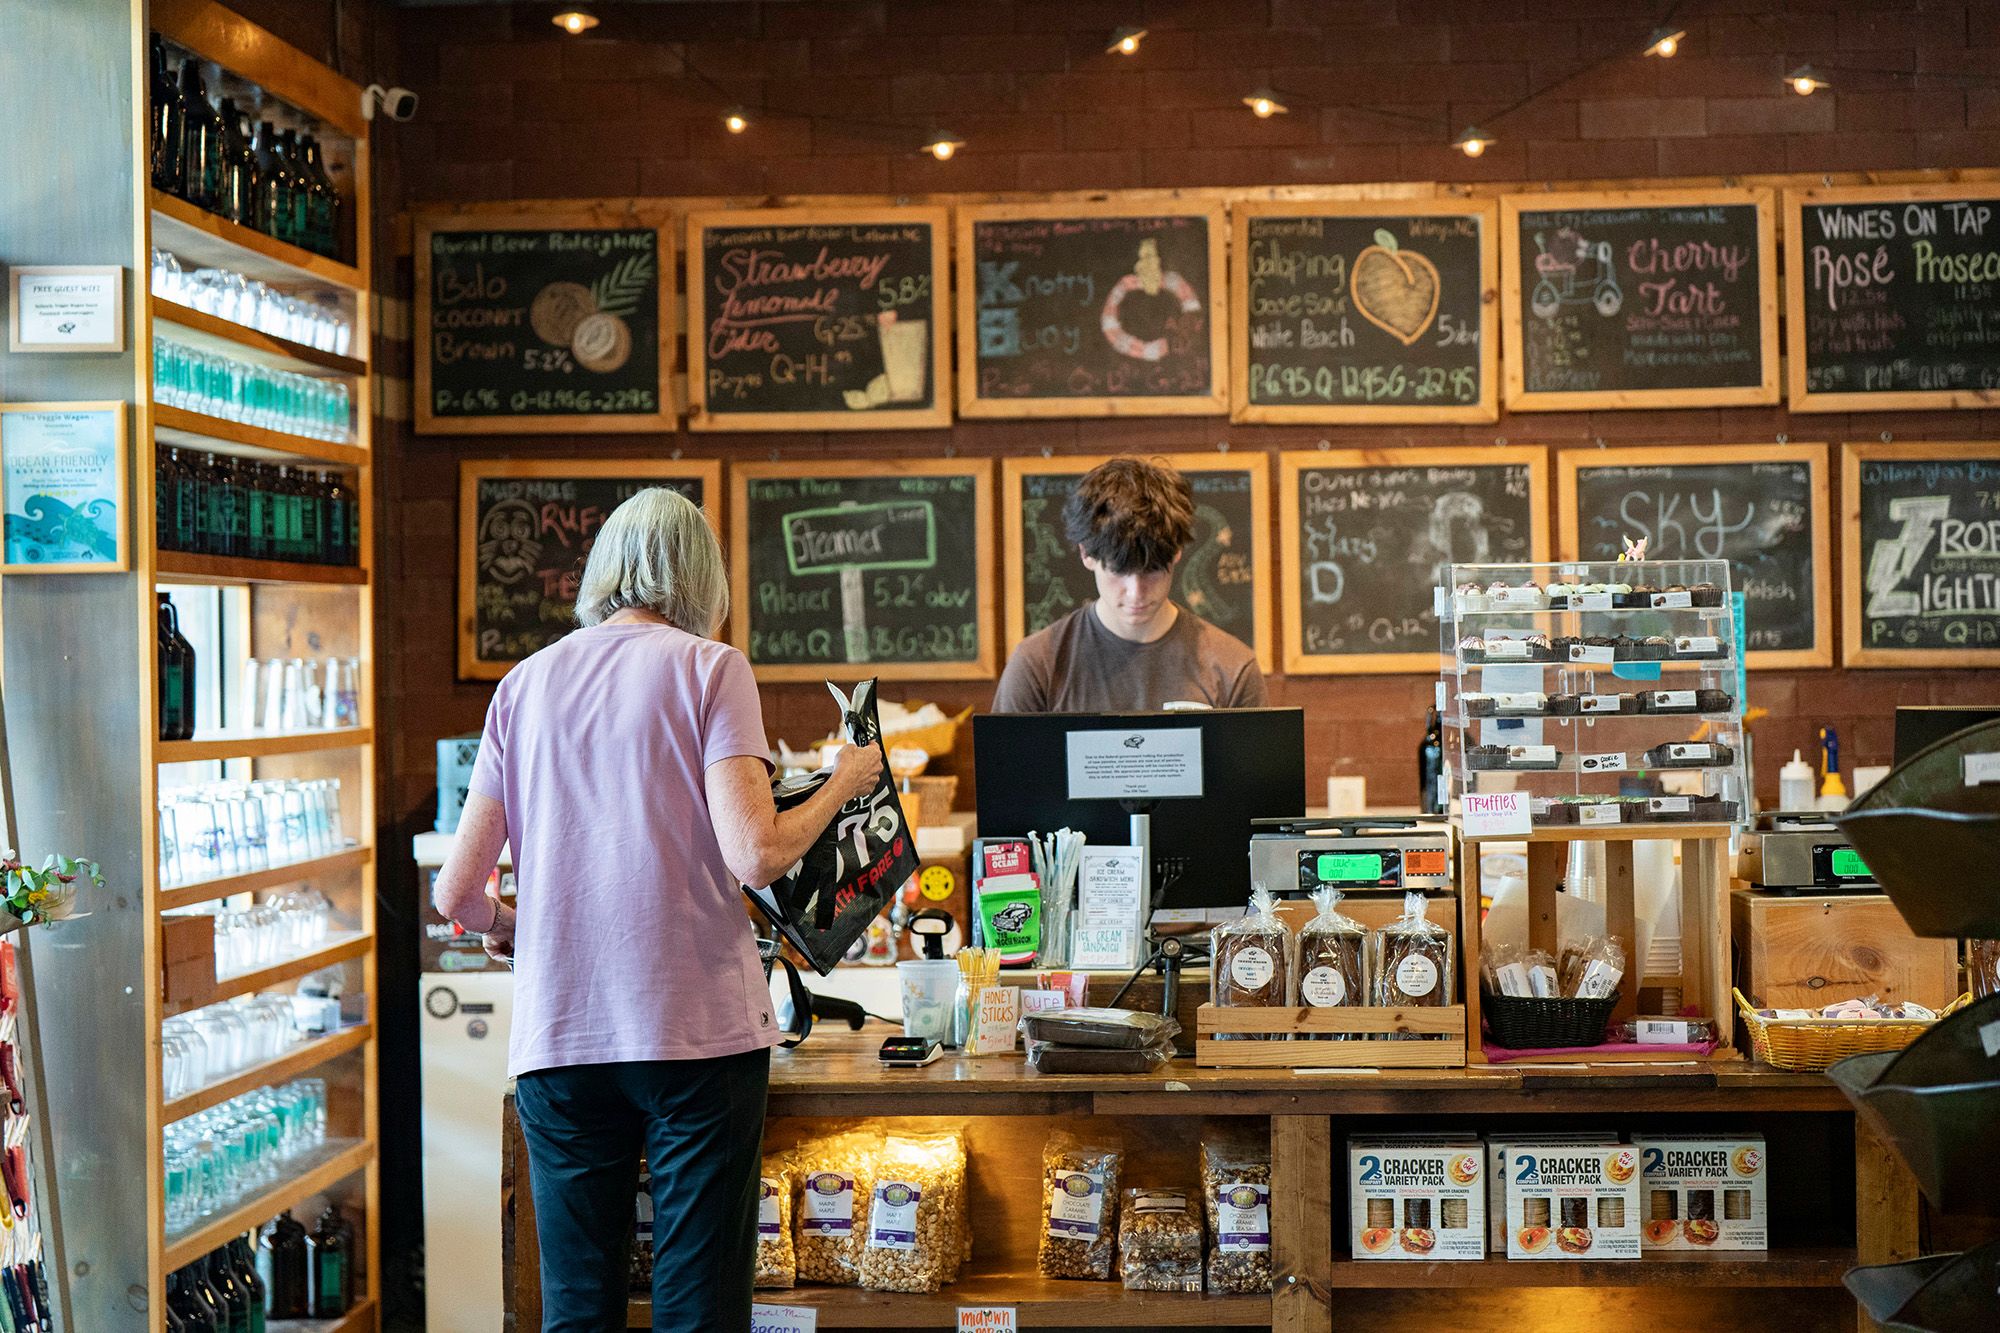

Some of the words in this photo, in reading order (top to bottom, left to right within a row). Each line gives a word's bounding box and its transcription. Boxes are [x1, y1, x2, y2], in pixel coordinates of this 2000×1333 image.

[1817, 207, 1897, 240] WINES
[1903, 204, 1938, 236] ON
[1942, 202, 1992, 236] TAP
[1628, 238, 1749, 282] Cherry
[1912, 240, 2000, 284] Prosec
[715, 246, 891, 296] Strawberry
[1639, 277, 1726, 318] Tart
[435, 332, 516, 365] Brown
[64, 413, 90, 421] Wagon
[10, 456, 50, 468] OCEAN
[54, 455, 109, 467] FRIENDLY
[841, 795, 871, 814] CE
[857, 849, 894, 893] FARE
[1097, 929, 1122, 943] CREAM
[1082, 943, 1120, 953] SANDWICH
[984, 989, 1013, 1005] HONEY
[1024, 995, 1060, 1009] cure
[981, 1006, 1014, 1024] STICKS
[1540, 1158, 1600, 1174] CRACKER
[1667, 1151, 1727, 1166] CRACKER
[1384, 1159, 1444, 1175] CRACKER
[1668, 1168, 1703, 1177] VARIETY
[1705, 1167, 1728, 1177] PACK
[1384, 1176, 1419, 1185] VARIETY
[1422, 1176, 1445, 1185] PACK
[1541, 1175, 1576, 1184] VARIETY
[1579, 1175, 1602, 1184] PACK
[1063, 1200, 1091, 1208] CHOCOLATE
[752, 1309, 779, 1317] oastal
